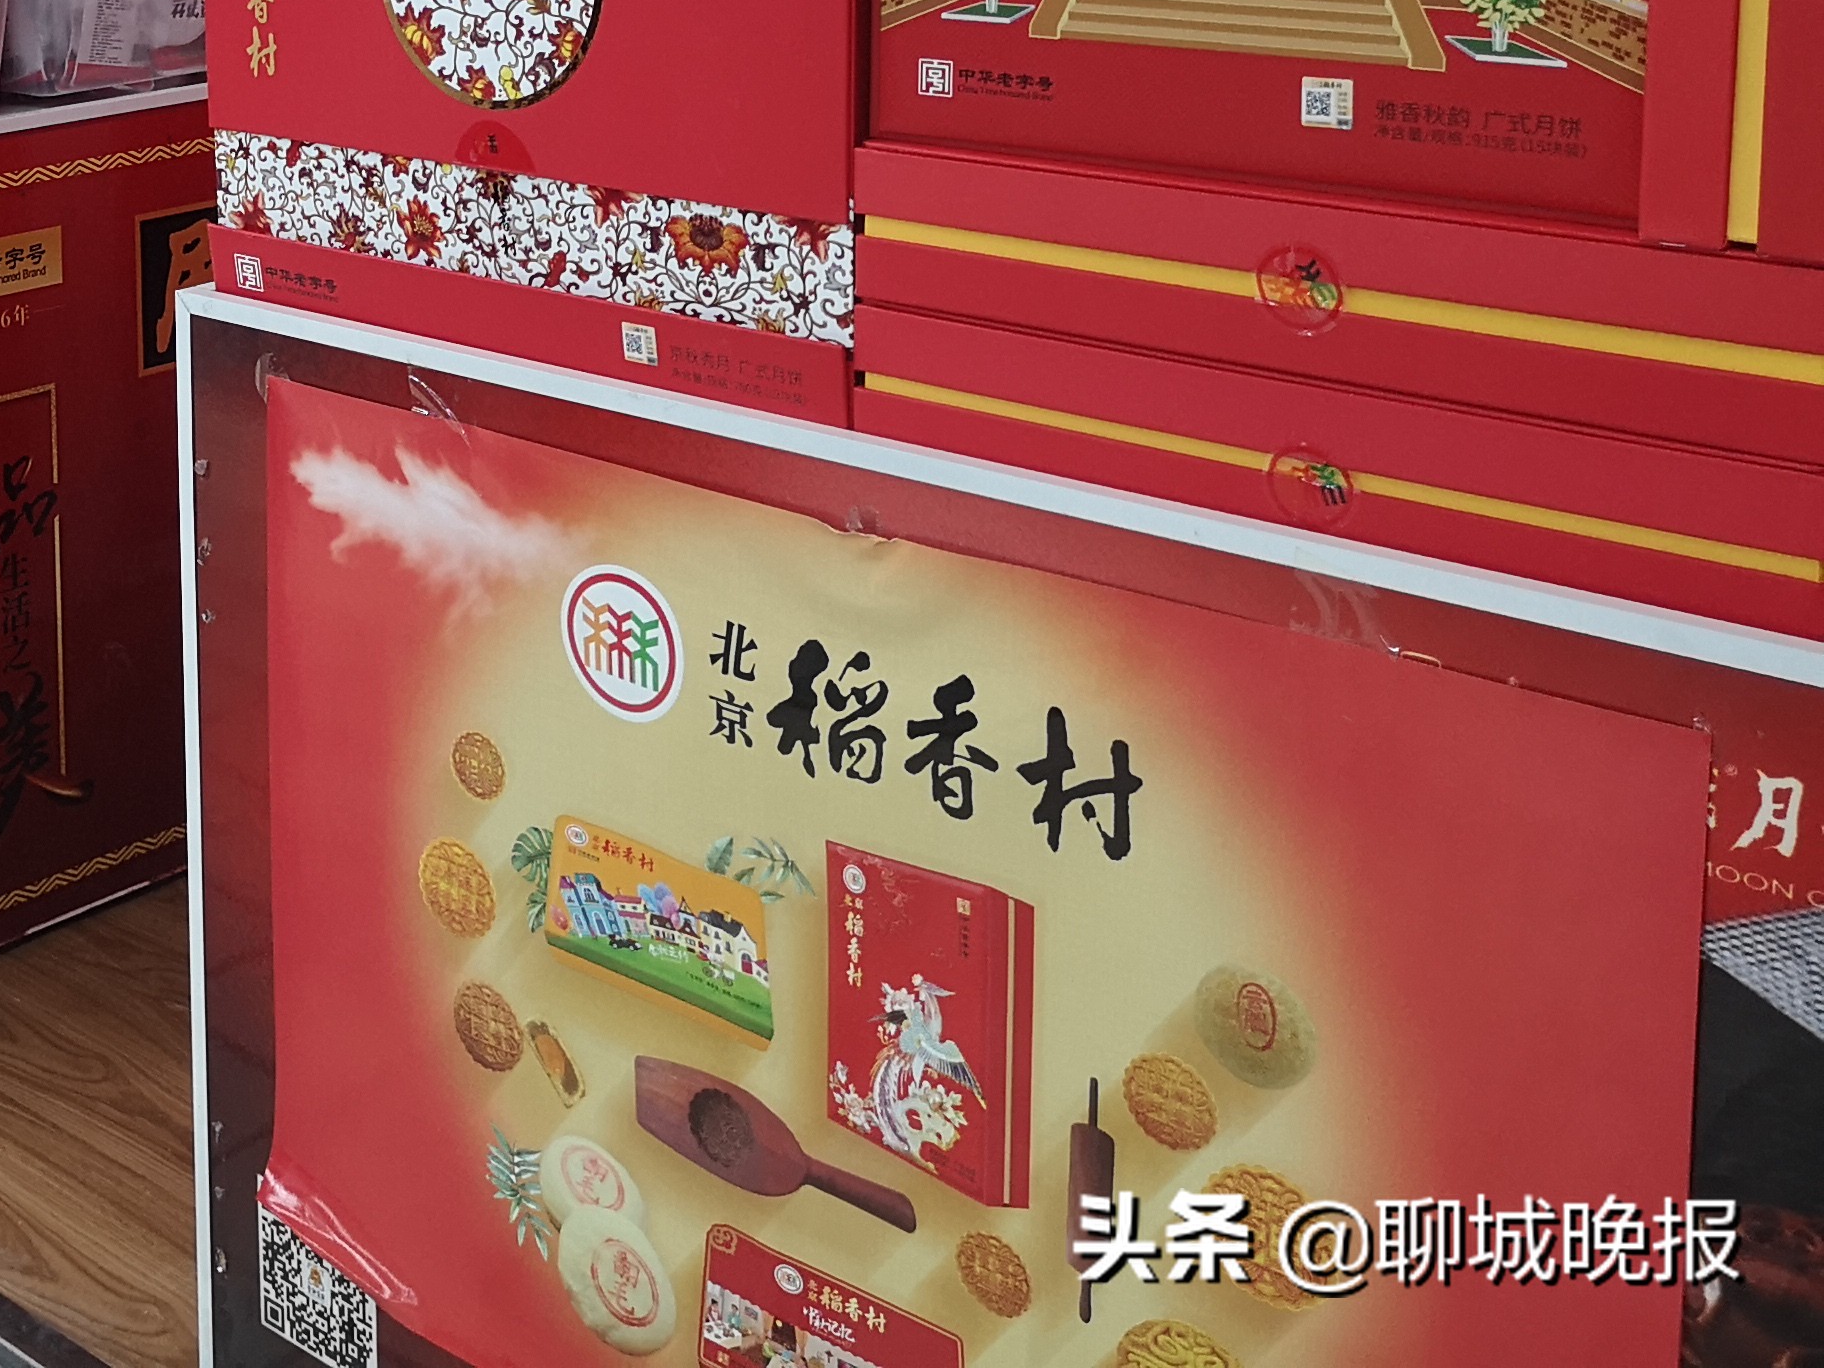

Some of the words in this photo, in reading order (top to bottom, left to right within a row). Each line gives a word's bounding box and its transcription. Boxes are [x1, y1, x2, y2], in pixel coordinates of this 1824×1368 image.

[959, 69, 1053, 92] 中华老字号
[1482, 110, 1583, 139] 广式月饼
[22, 265, 47, 280] Brand
[708, 620, 759, 749] 北京
[766, 639, 1144, 861] 稻香村
[844, 911, 864, 988] 稻香村
[819, 1285, 886, 1334] 稻香村
